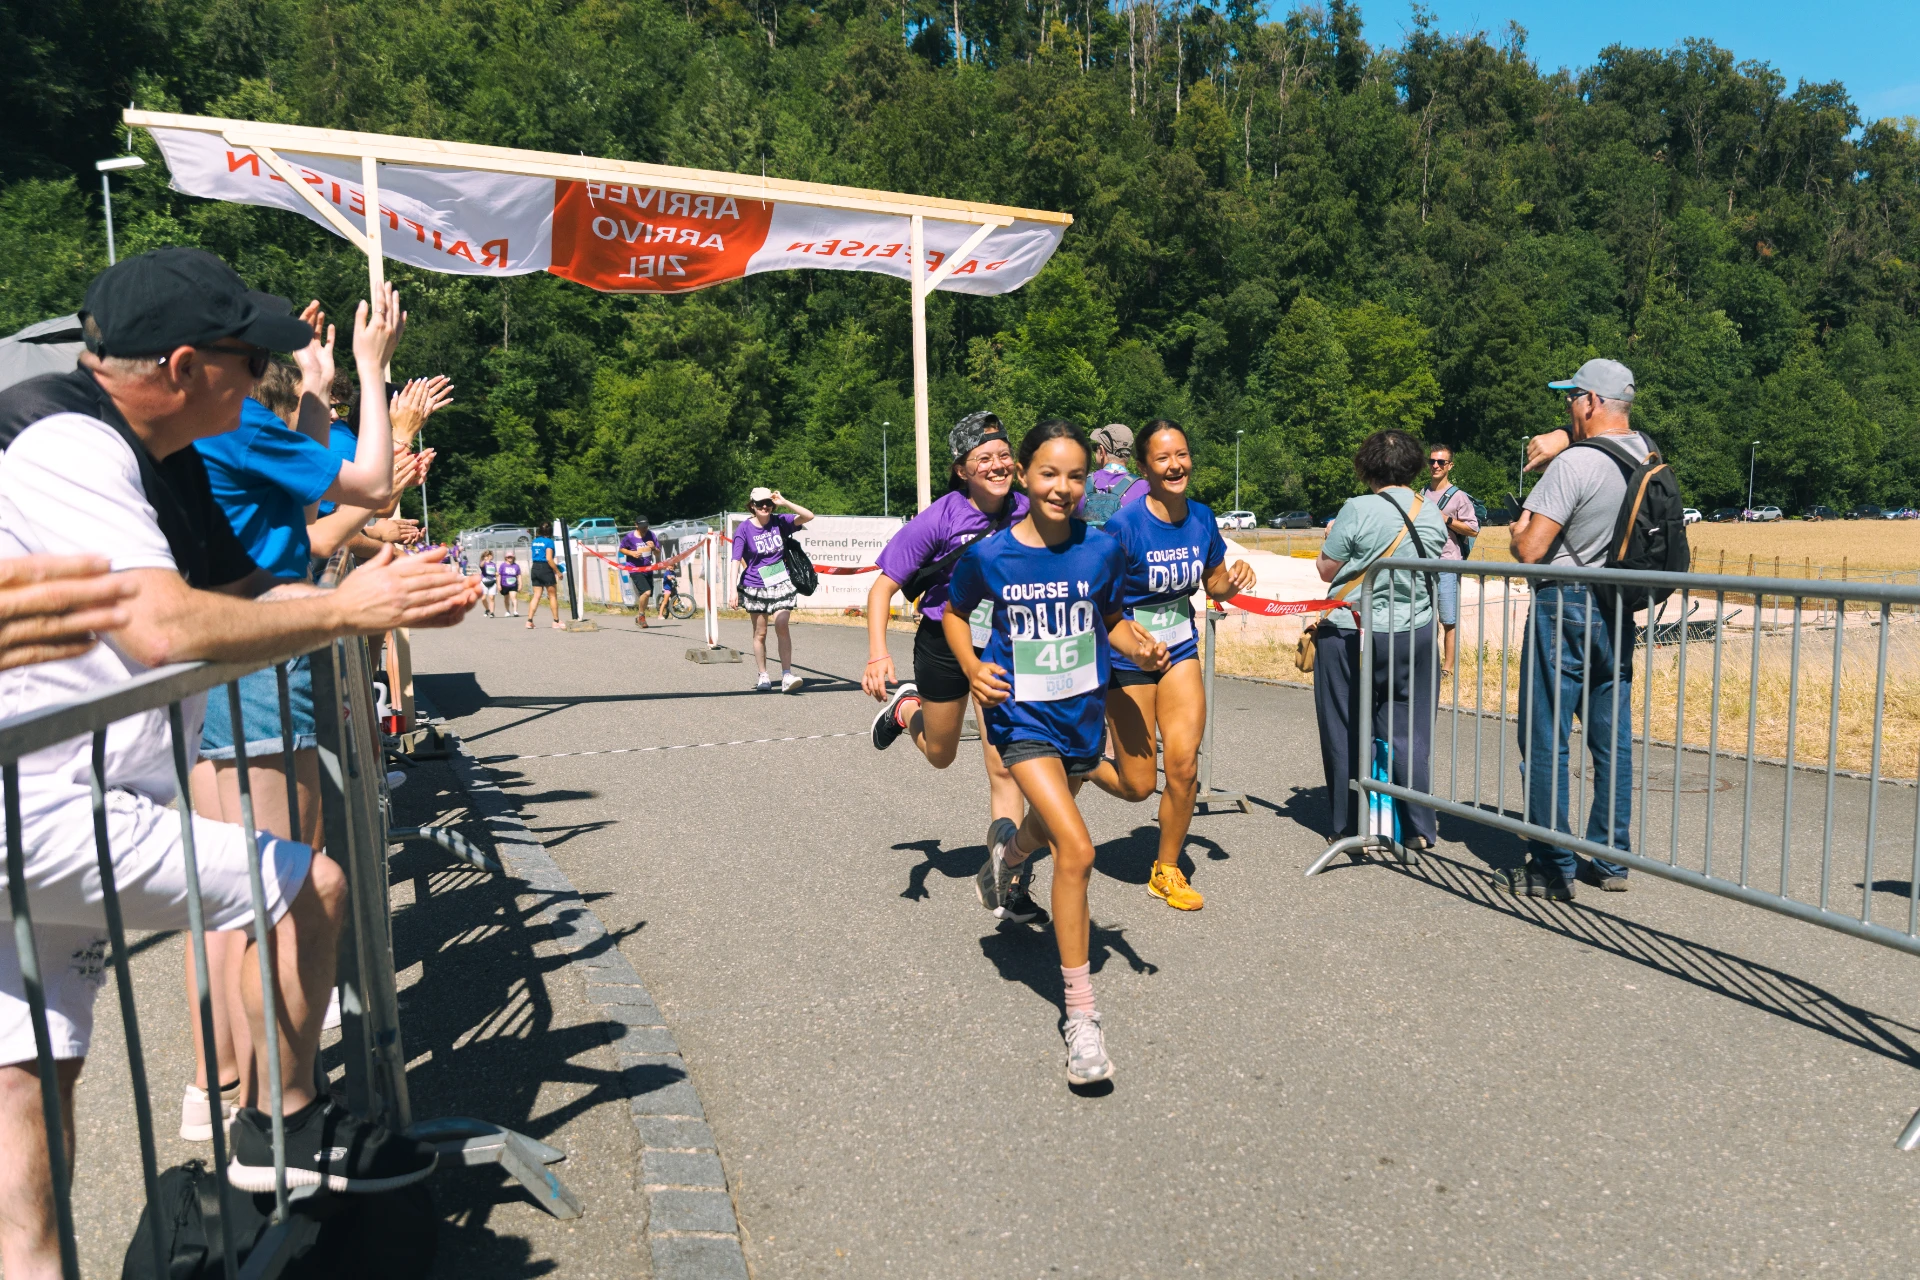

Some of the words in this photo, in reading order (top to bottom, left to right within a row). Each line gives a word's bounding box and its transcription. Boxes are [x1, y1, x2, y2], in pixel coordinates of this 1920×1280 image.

[755, 534, 783, 554] DUO
[804, 537, 848, 548] Fernand
[851, 538, 883, 548] Perrin
[1146, 547, 1189, 562] COURSE
[1148, 559, 1204, 593] DUO
[1002, 581, 1069, 601] COURSE
[1151, 602, 1179, 627] 47
[1264, 602, 1308, 614] RAIFFEISEN
[1007, 600, 1094, 641] DUO
[1035, 639, 1079, 671] 46
[1046, 677, 1073, 692] DUO
